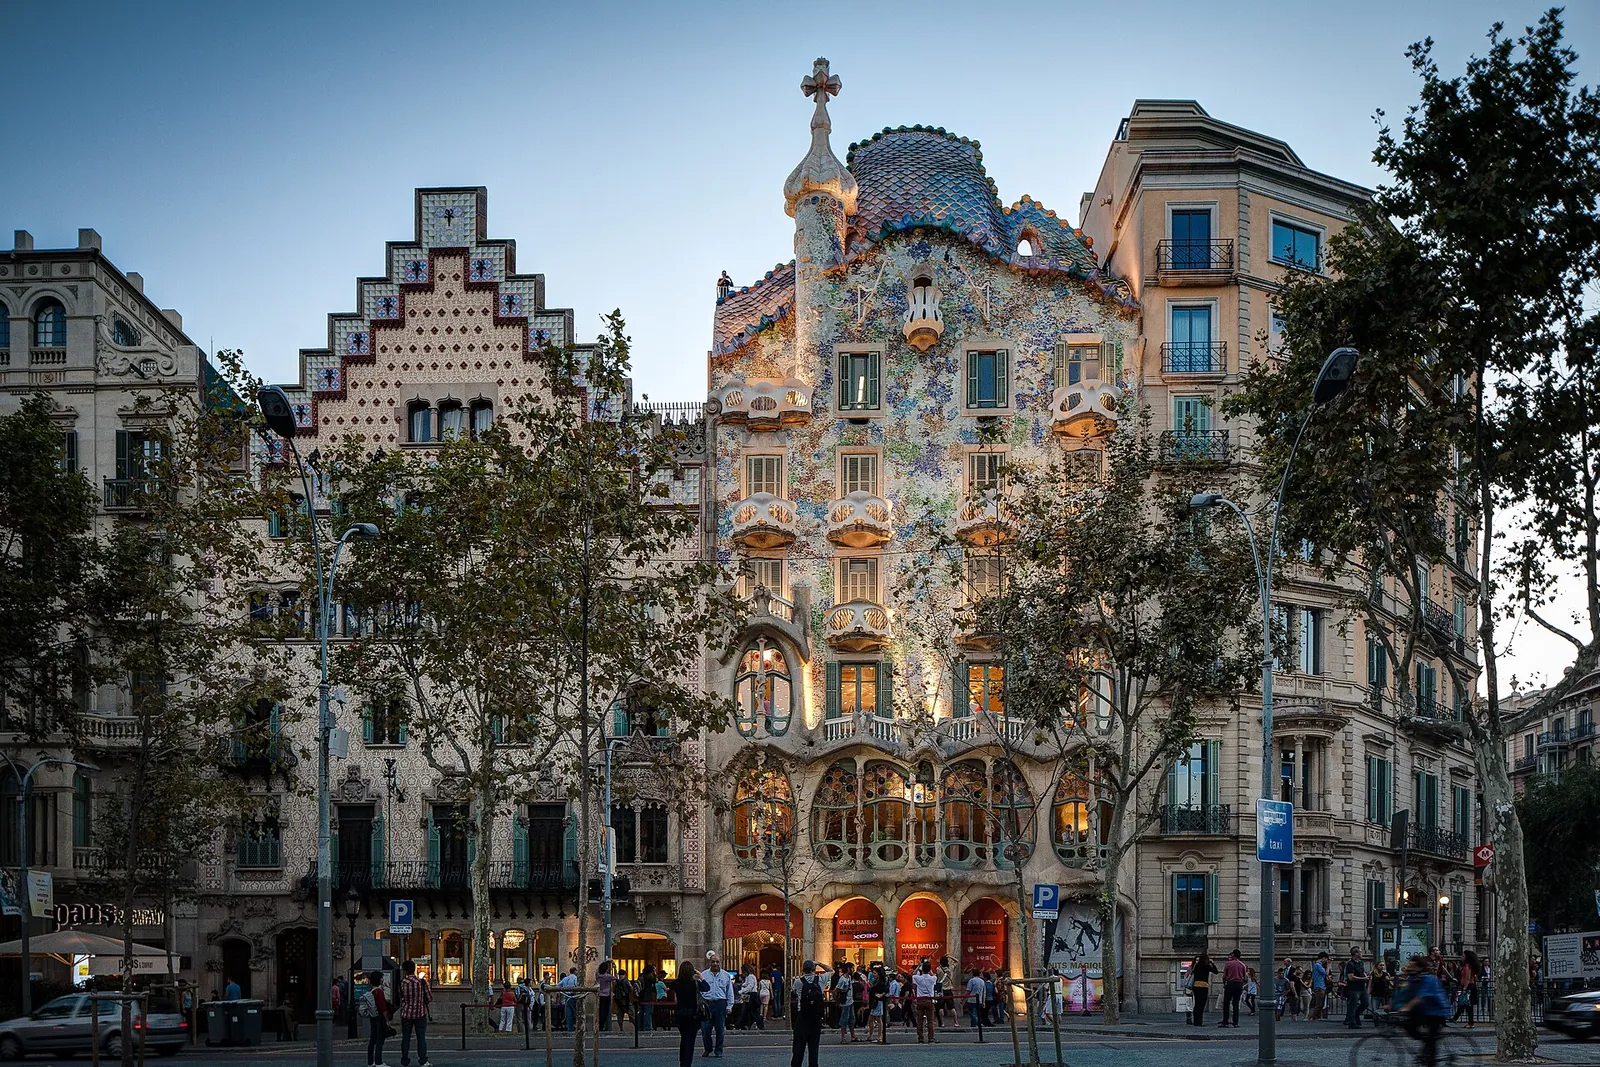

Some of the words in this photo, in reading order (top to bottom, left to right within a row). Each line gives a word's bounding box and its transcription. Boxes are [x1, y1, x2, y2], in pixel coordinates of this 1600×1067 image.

[1269, 839, 1283, 850] taxi
[1039, 887, 1054, 907] P
[394, 903, 408, 922] P
